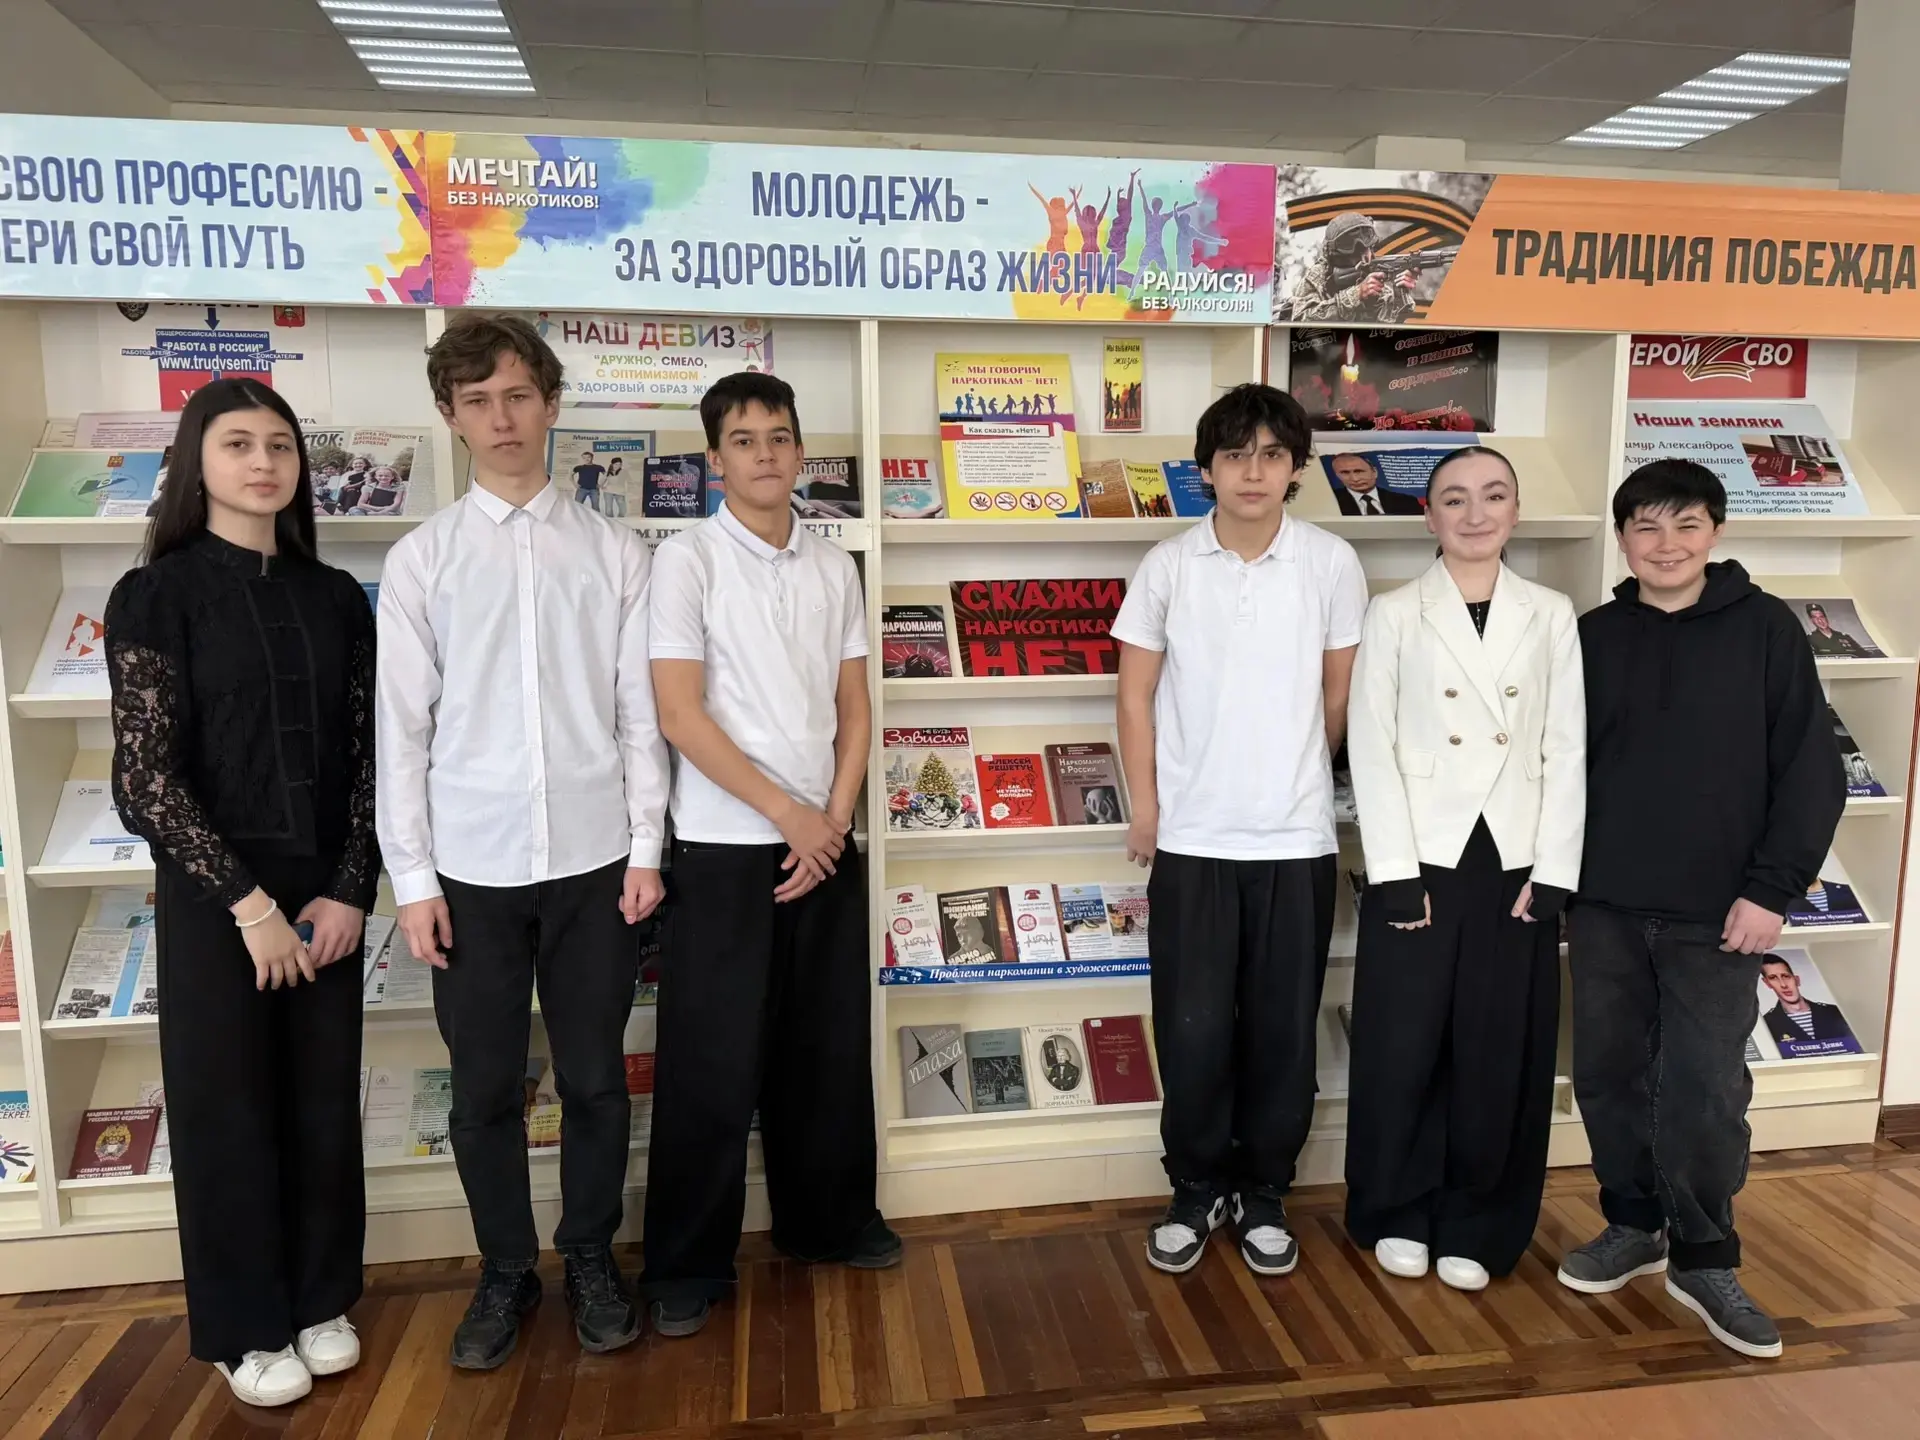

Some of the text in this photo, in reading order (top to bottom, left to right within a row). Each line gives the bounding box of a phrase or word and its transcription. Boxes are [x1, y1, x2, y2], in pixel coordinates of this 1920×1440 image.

[448, 156, 598, 188] МЕЧТАЙ!
[115, 159, 363, 212] ПРОФЕССИЮ
[448, 191, 599, 208] БЕЗ НАРКОТИКОВ!
[752, 171, 965, 226] МОЛОДЕЖЬ
[89, 215, 191, 267] СВОЙ
[201, 224, 305, 270] ПУТЬ
[615, 236, 1117, 294] ЗА ЗДОРОВЫЙ ОБРАЗ ЖИЗНИ
[1492, 228, 1916, 294] ТРАДИЦИЯ ПОБЕЖДА
[1143, 270, 1255, 293] РАДУЙСЯ!
[1142, 297, 1253, 311] БЕЗ АЛКОГОЛЯ!
[156, 330, 217, 338] ОБЩЕРОССИЙСКАЯ
[218, 331, 234, 339] БАЗА
[563, 320, 735, 350] НАШ ДЕВИЗ
[210, 343, 217, 352] В
[1743, 343, 1793, 366] СВО
[161, 357, 269, 371] www.trudvsem.ru
[661, 356, 708, 368] СМЕЛО,
[596, 369, 607, 378] С
[612, 369, 698, 380] ОПТИМИЗМОМ
[967, 366, 1041, 374] МЫ ГОВОРИМ
[577, 382, 645, 393] ЗДОРОВЫЙ
[650, 384, 688, 394] ОБРАЗ
[952, 377, 1023, 385] НАРКОТИКАМ
[1036, 377, 1058, 385] НЕТ!
[1633, 413, 1784, 429] Наши земляки
[1659, 441, 1734, 451] Александров
[882, 459, 928, 478] НЕТ
[801, 524, 842, 537] ЕТ!
[961, 581, 1122, 611] СКАЖИ
[882, 621, 943, 632] НАРКОМАНИЯ
[969, 640, 1122, 677] НЕТ
[885, 729, 967, 744] Зависим
[963, 951, 996, 965] АНИЯ!
[929, 967, 984, 979] Проблема
[988, 965, 1054, 979] наркомании
[1057, 966, 1063, 974] в
[909, 1039, 963, 1084] плаха
